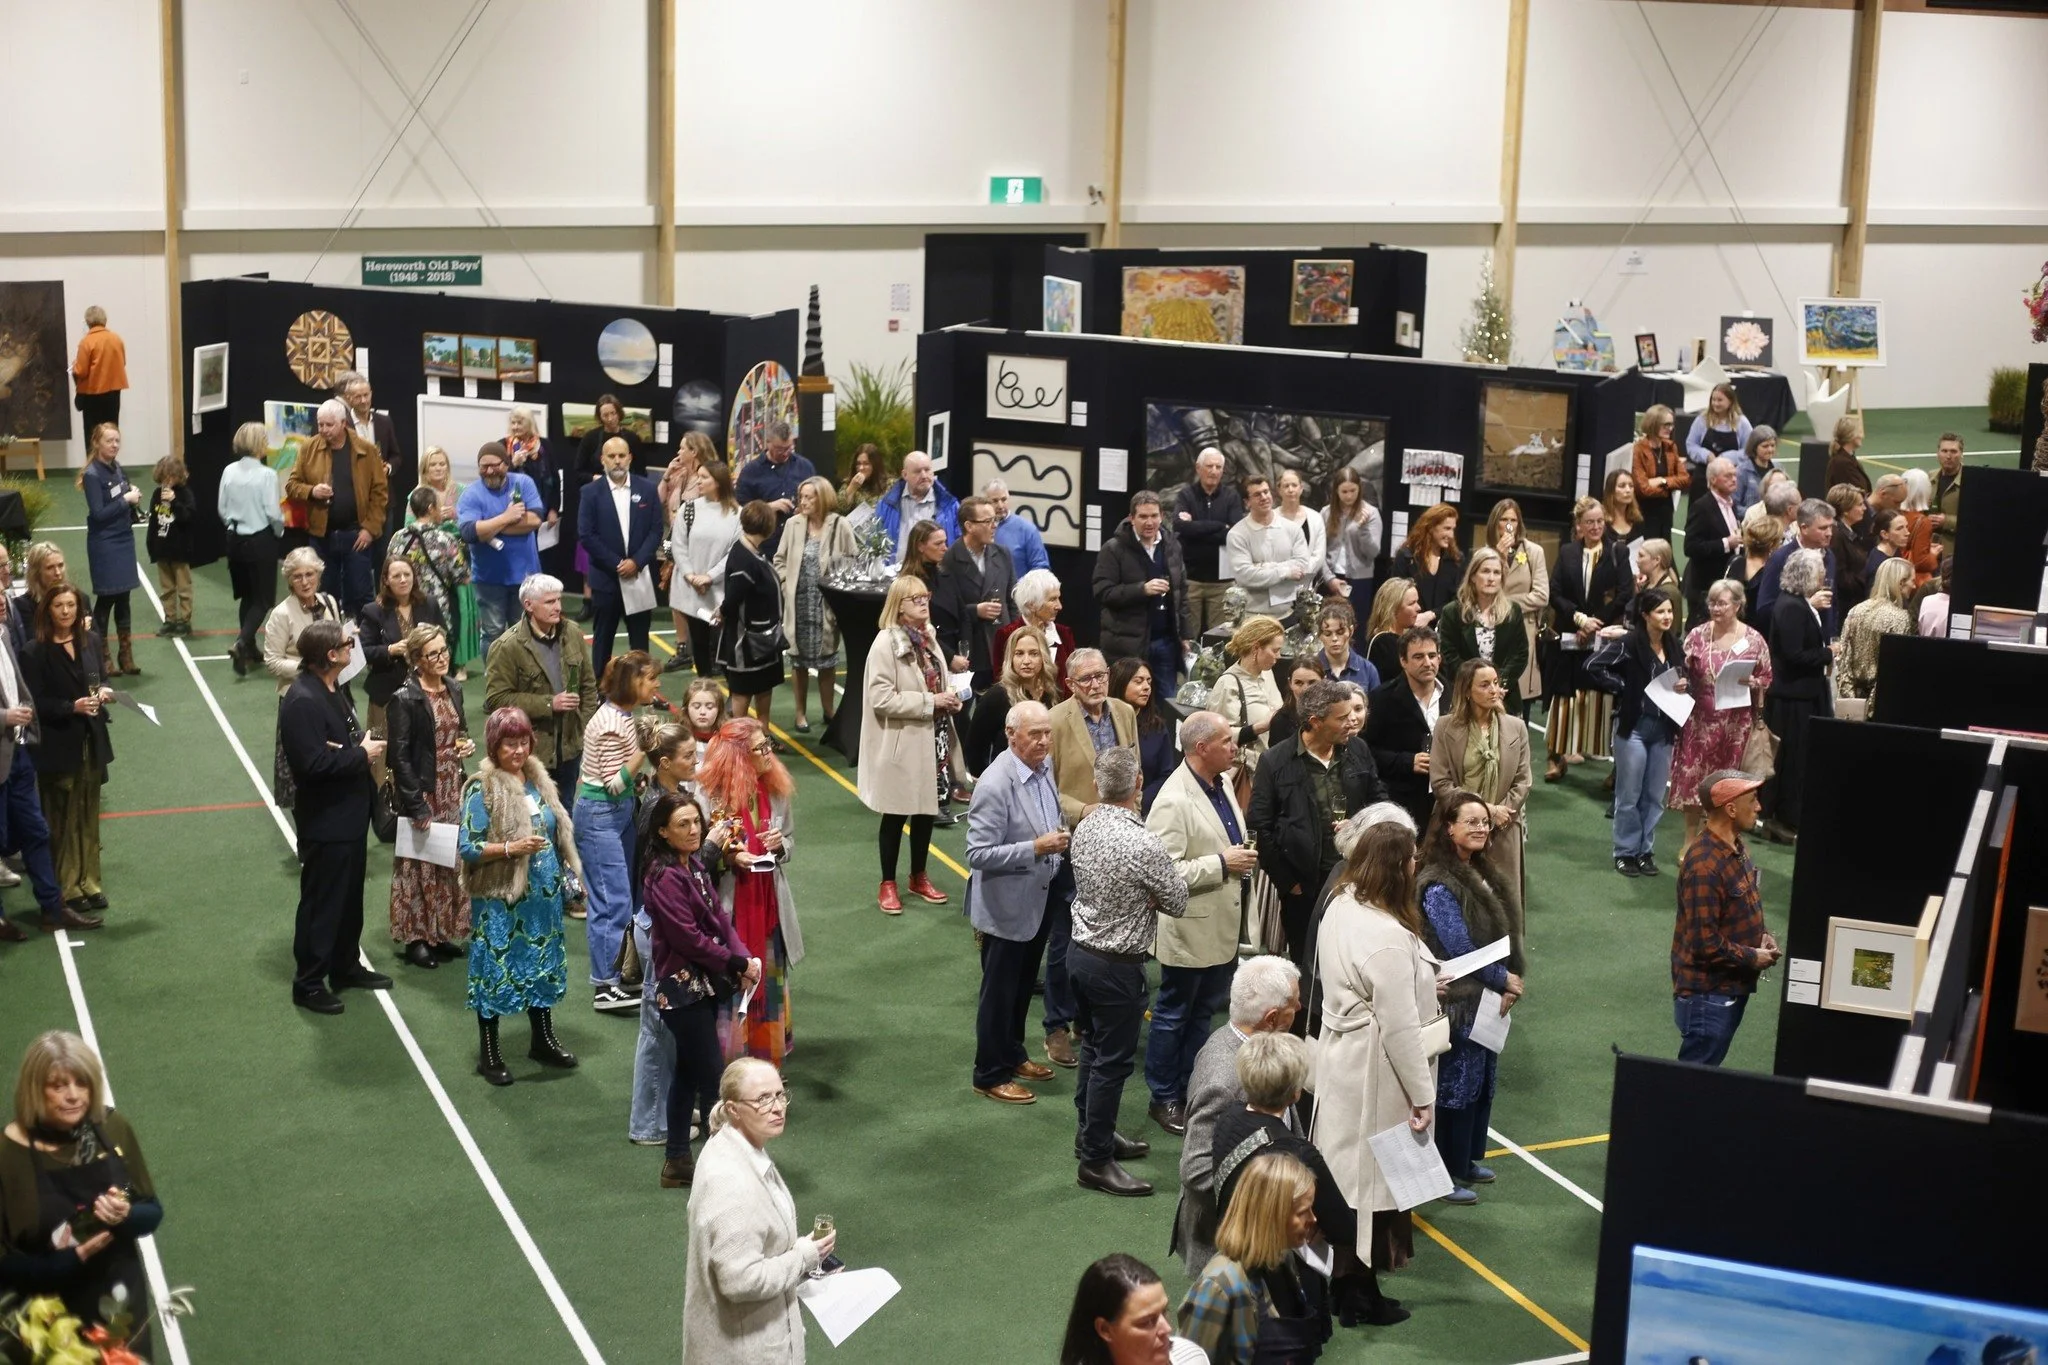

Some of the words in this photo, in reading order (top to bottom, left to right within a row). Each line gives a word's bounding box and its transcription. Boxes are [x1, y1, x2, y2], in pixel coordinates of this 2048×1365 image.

[365, 261, 426, 271] Hereworth
[428, 260, 449, 270] Old
[389, 272, 418, 284] (1948
[426, 271, 456, 283] 2018)
